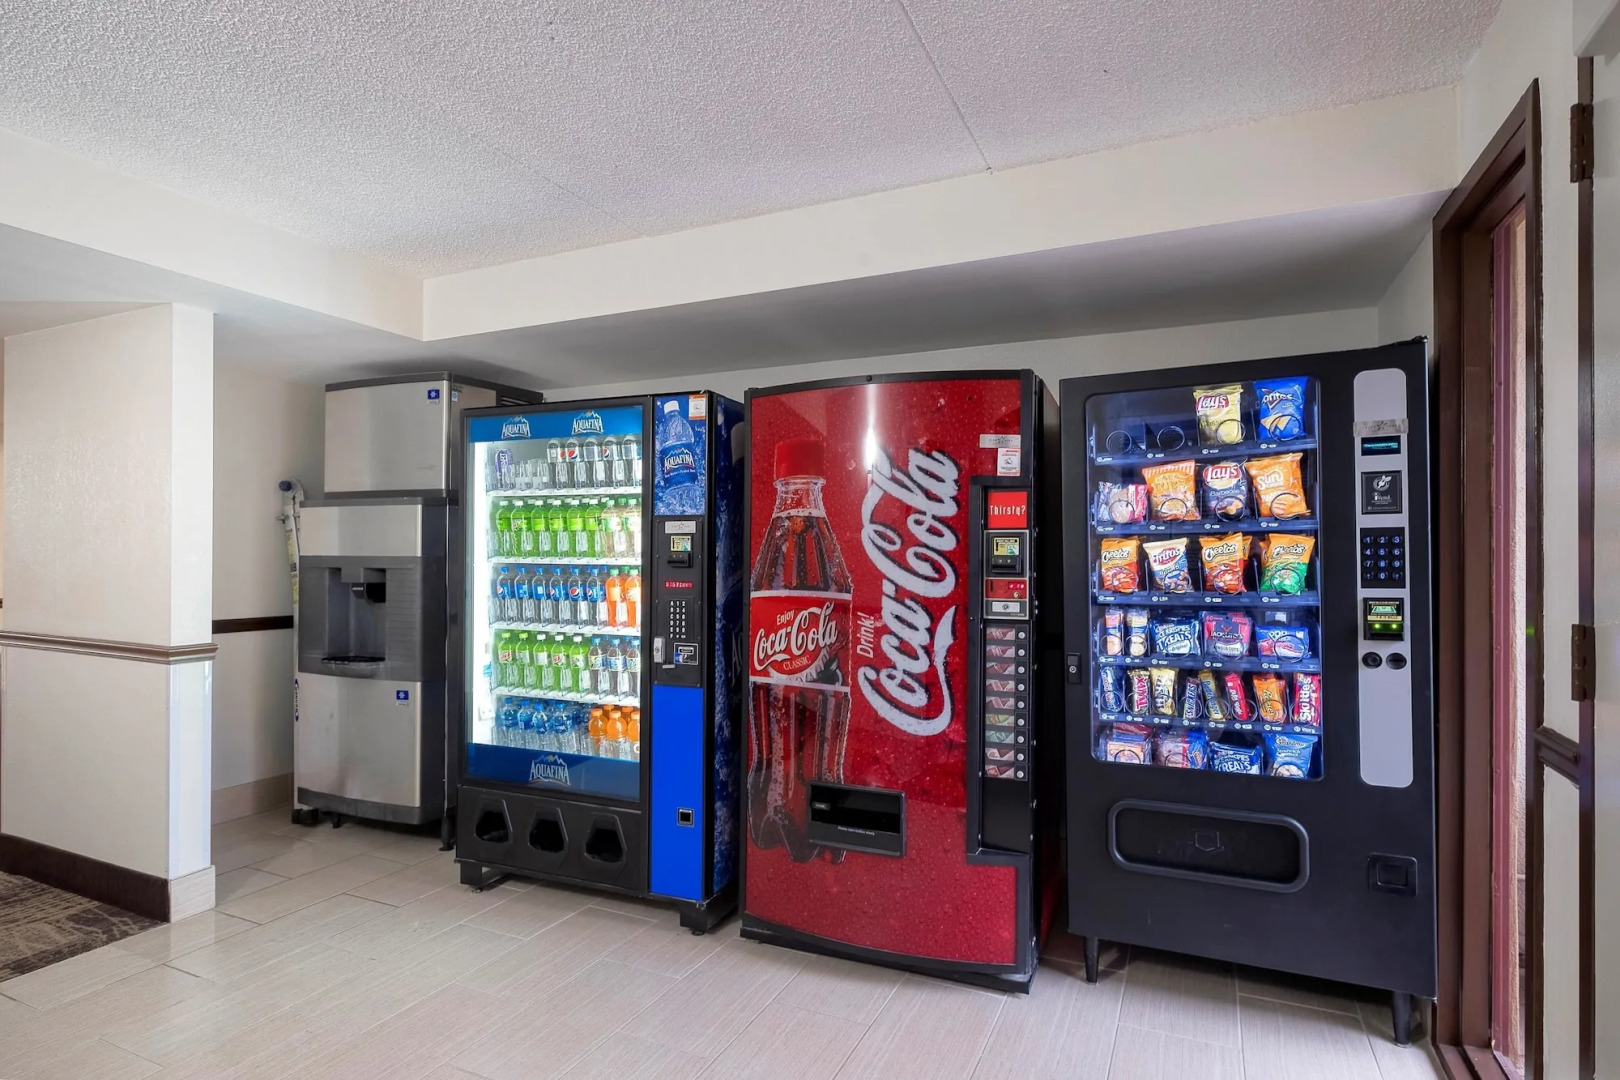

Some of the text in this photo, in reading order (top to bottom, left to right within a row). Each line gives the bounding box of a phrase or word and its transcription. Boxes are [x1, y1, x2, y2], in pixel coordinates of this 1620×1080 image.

[501, 423, 531, 438] AQUAFINA
[572, 418, 604, 434] AQUAFINA
[665, 453, 695, 472] AQUAFINA
[990, 505, 1026, 516] Thirsty?
[1102, 548, 1130, 563] Cheetos
[1153, 548, 1181, 564] Fritos
[1204, 543, 1236, 562] Cheetos
[859, 444, 961, 736] Coca-Cola
[777, 610, 795, 625] Enjoy
[754, 601, 838, 670] Coca-Cola
[856, 612, 875, 658] Drink!
[783, 655, 812, 670] CLASSIC
[1186, 683, 1197, 718] SNICKERS
[1299, 677, 1312, 722] Skittles
[529, 761, 571, 785] AQUAFINA
